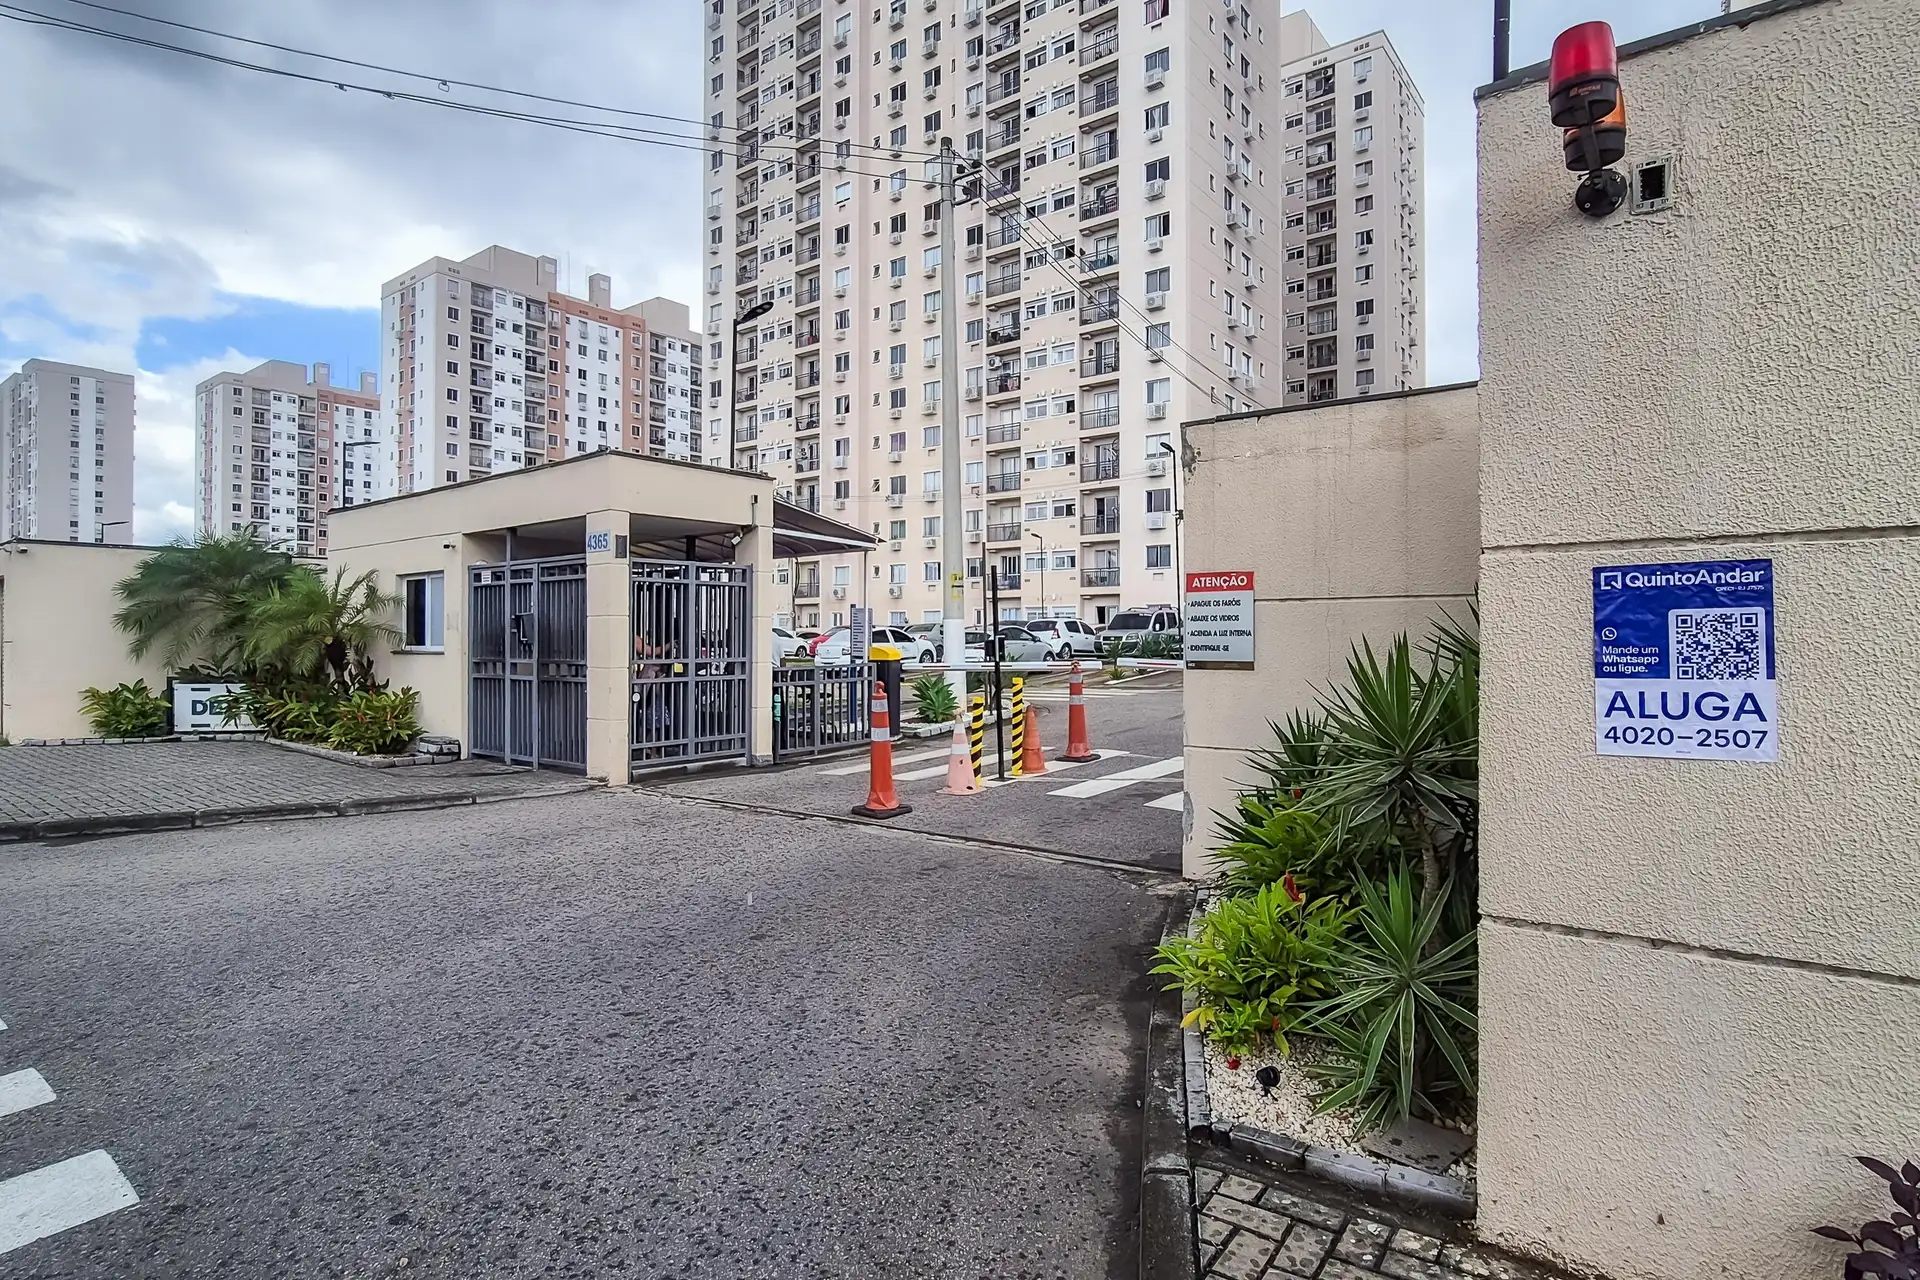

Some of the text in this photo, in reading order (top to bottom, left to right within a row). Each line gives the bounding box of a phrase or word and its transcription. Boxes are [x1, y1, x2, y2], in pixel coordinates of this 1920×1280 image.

[588, 533, 608, 550] 4365
[1192, 573, 1248, 589] ATENÇÃO
[1625, 568, 1765, 588] QuintoAndar
[1221, 598, 1241, 606] FARÓIS
[1602, 645, 1639, 654] Mande
[1602, 655, 1659, 665] Whatsapp
[1618, 664, 1649, 674] ligue.
[1604, 690, 1768, 723] ALUGA
[1604, 726, 1768, 749] 4020-2507
